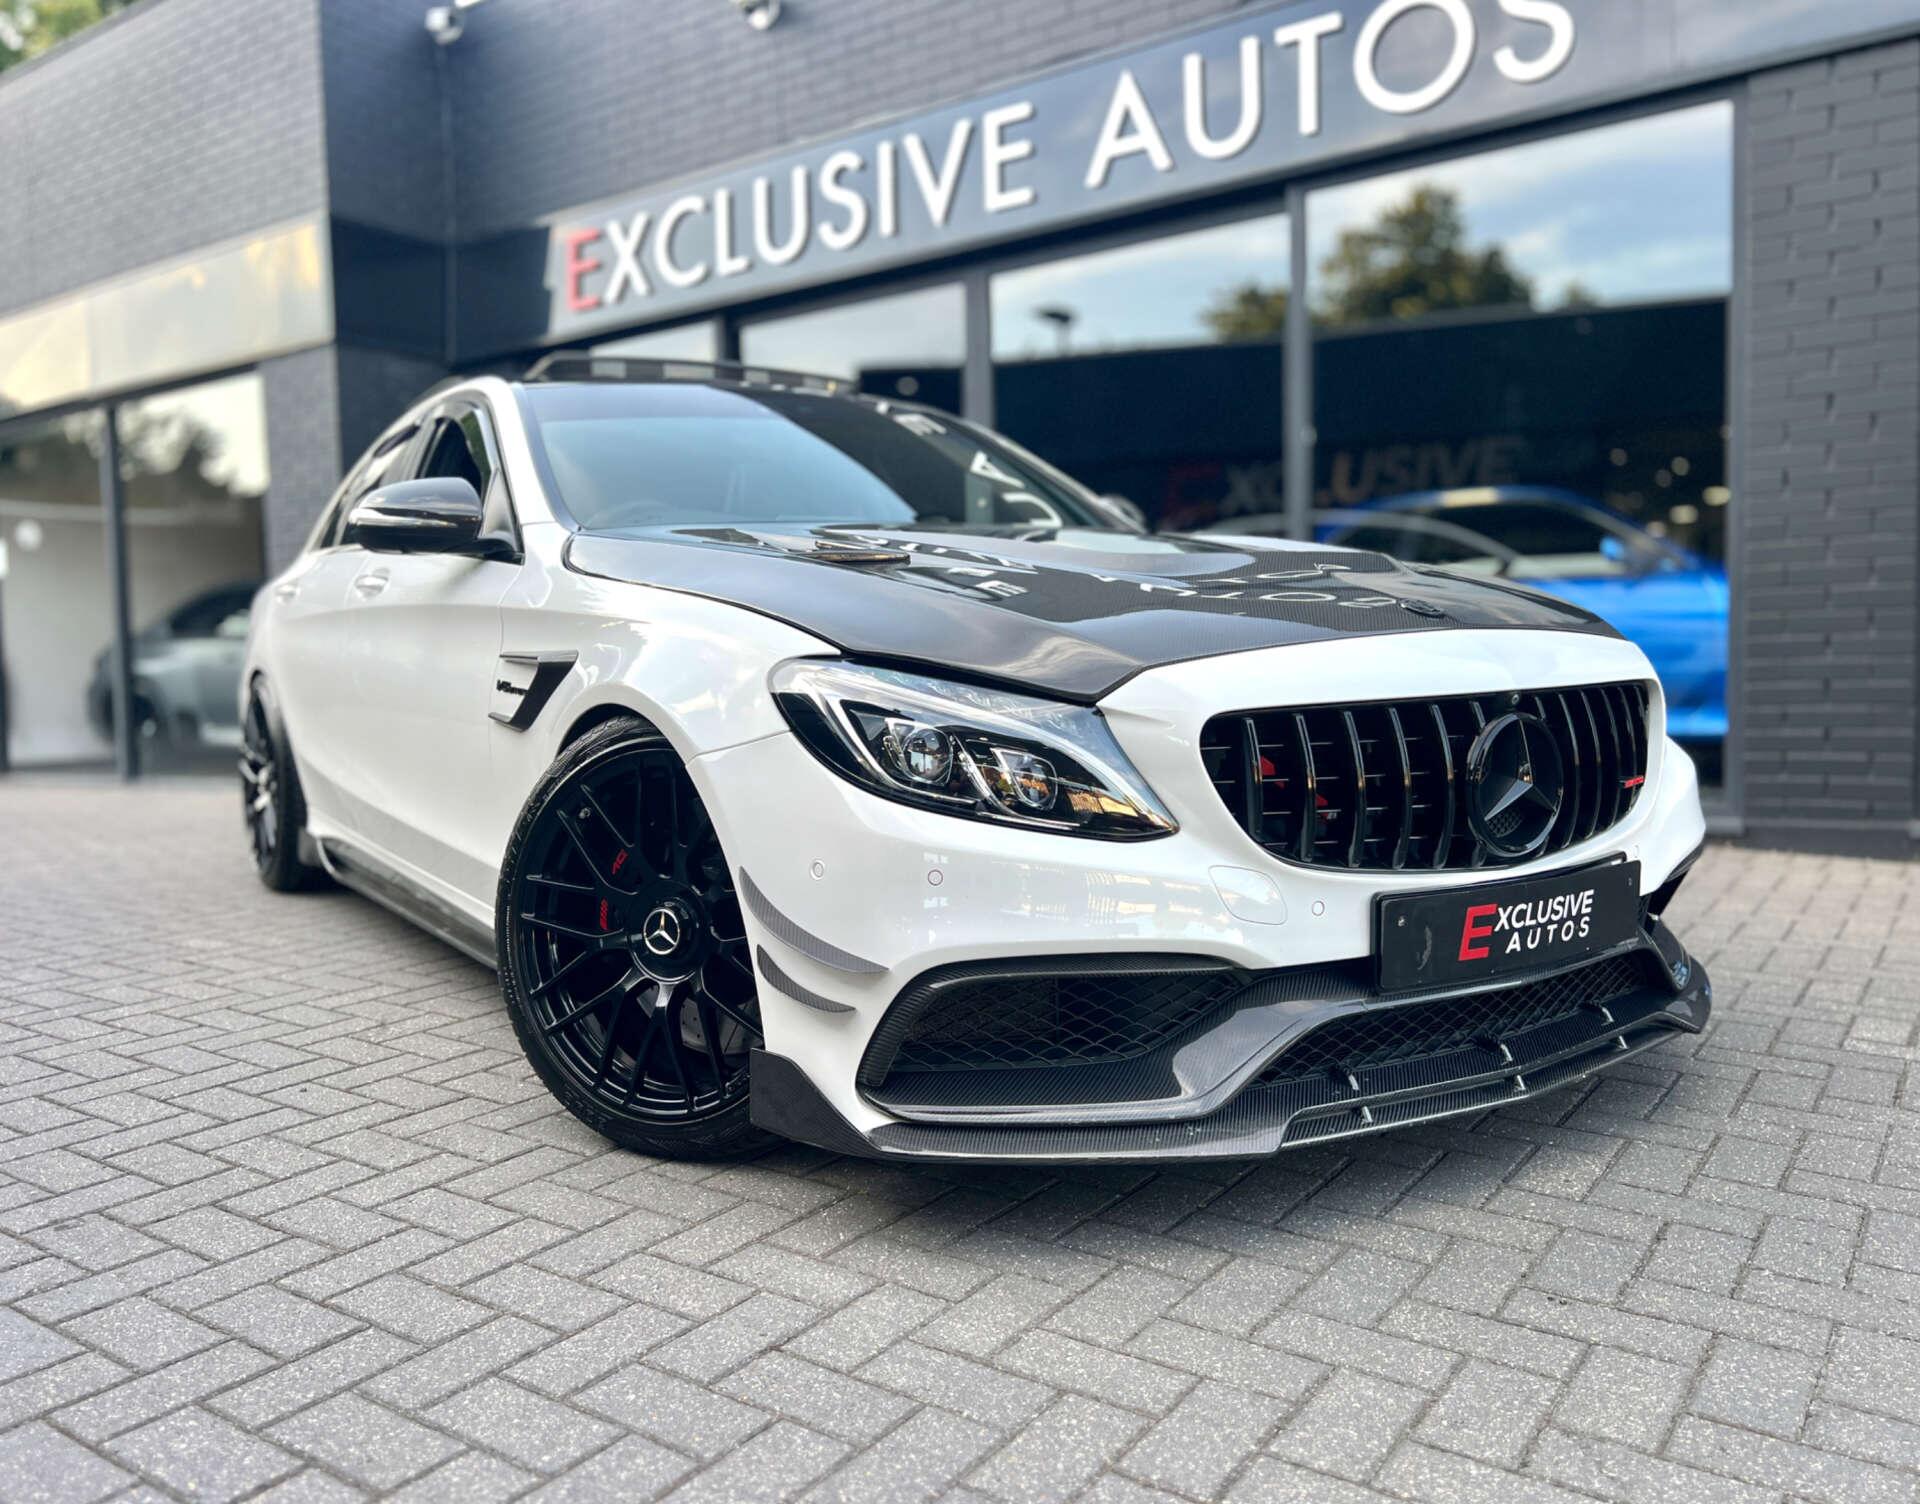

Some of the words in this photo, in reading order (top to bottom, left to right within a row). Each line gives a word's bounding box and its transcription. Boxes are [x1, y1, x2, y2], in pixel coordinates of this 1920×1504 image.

[565, 101, 1034, 311] EXCLUSIVE
[1084, 0, 1574, 189] AUTOS
[1457, 888, 1595, 961] EXCLUSIVE
[1504, 915, 1590, 954] AUTOS
